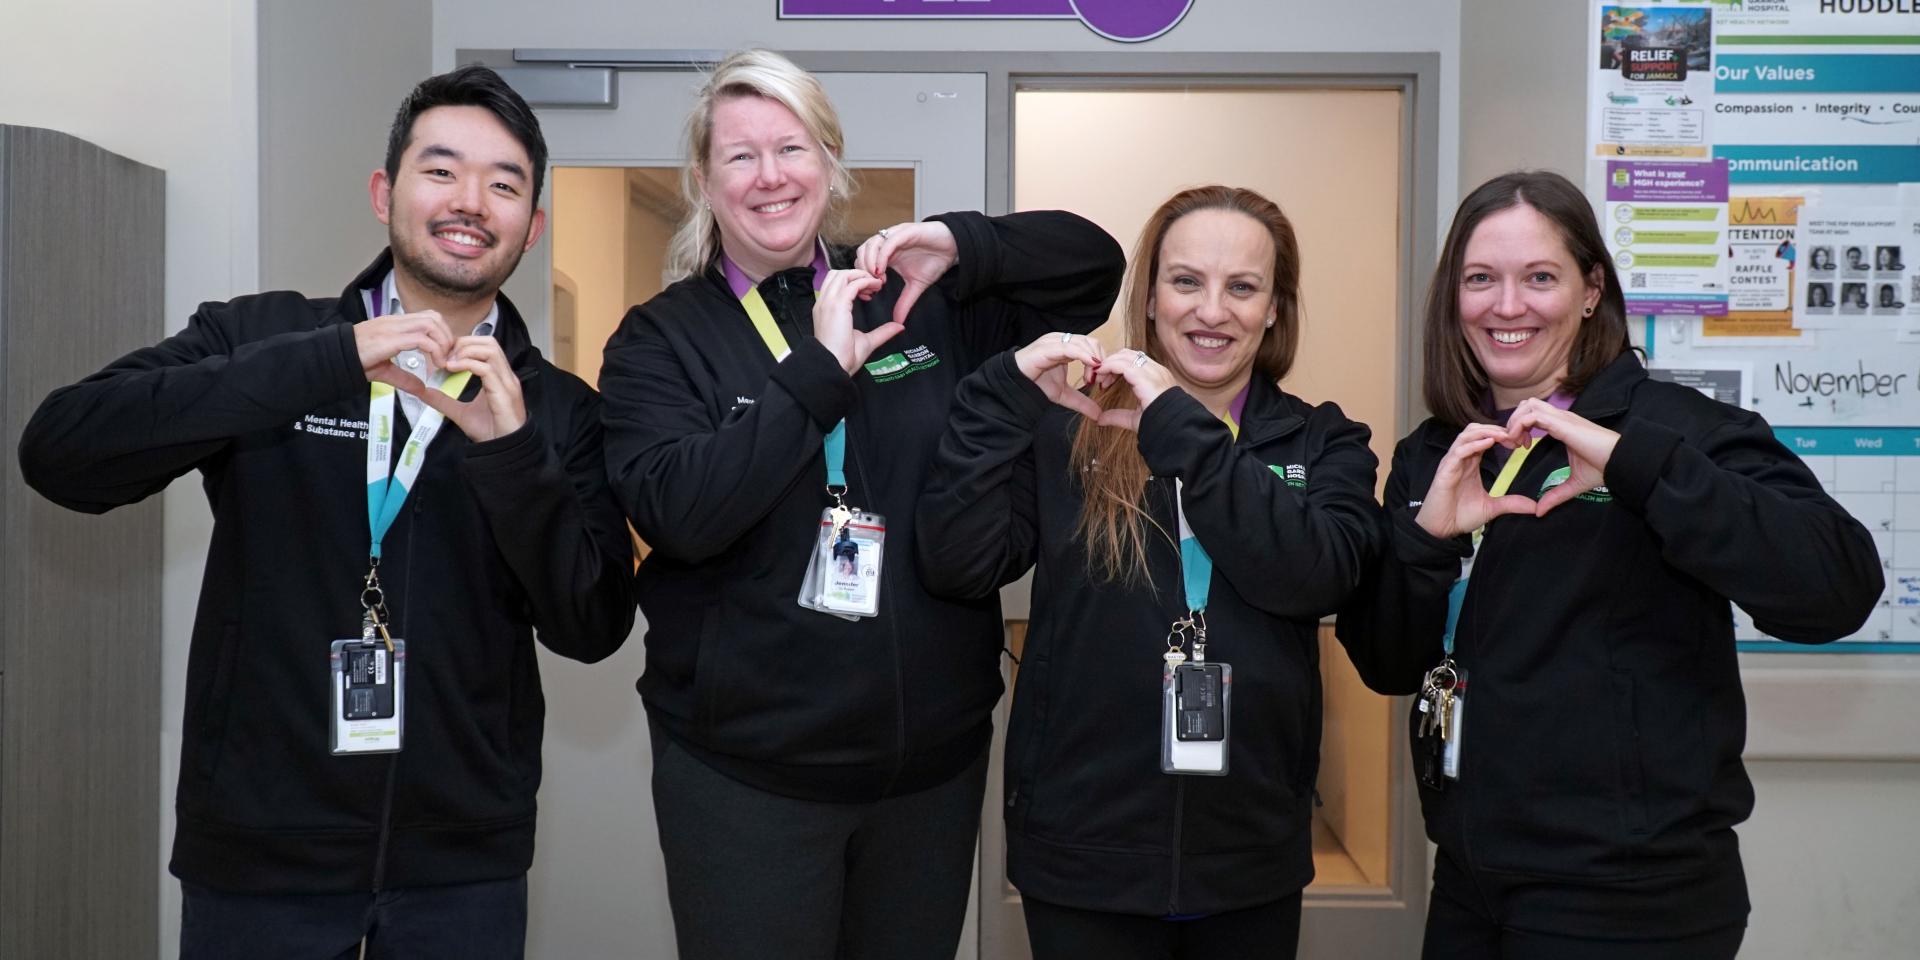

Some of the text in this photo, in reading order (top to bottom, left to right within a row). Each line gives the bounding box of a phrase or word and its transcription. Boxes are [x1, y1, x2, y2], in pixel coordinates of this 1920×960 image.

[1631, 50, 1674, 61] RELIEF
[1632, 63, 1679, 72] SUPPORT
[1715, 65, 1815, 80] Our Values
[1715, 103, 1793, 114] Compassion
[1815, 103, 1871, 115] Integrity
[1728, 156, 1858, 171] ommunication
[1655, 179, 1705, 188] experience?
[1728, 229, 1795, 240] TTENTION
[1736, 265, 1772, 273] RAFFLE
[1730, 276, 1777, 284] CONTEST
[1776, 360, 1906, 398] November
[304, 414, 369, 430] Mental Health
[294, 421, 302, 430] &
[306, 424, 356, 438] Substance
[1795, 437, 1883, 448] Tue Wed
